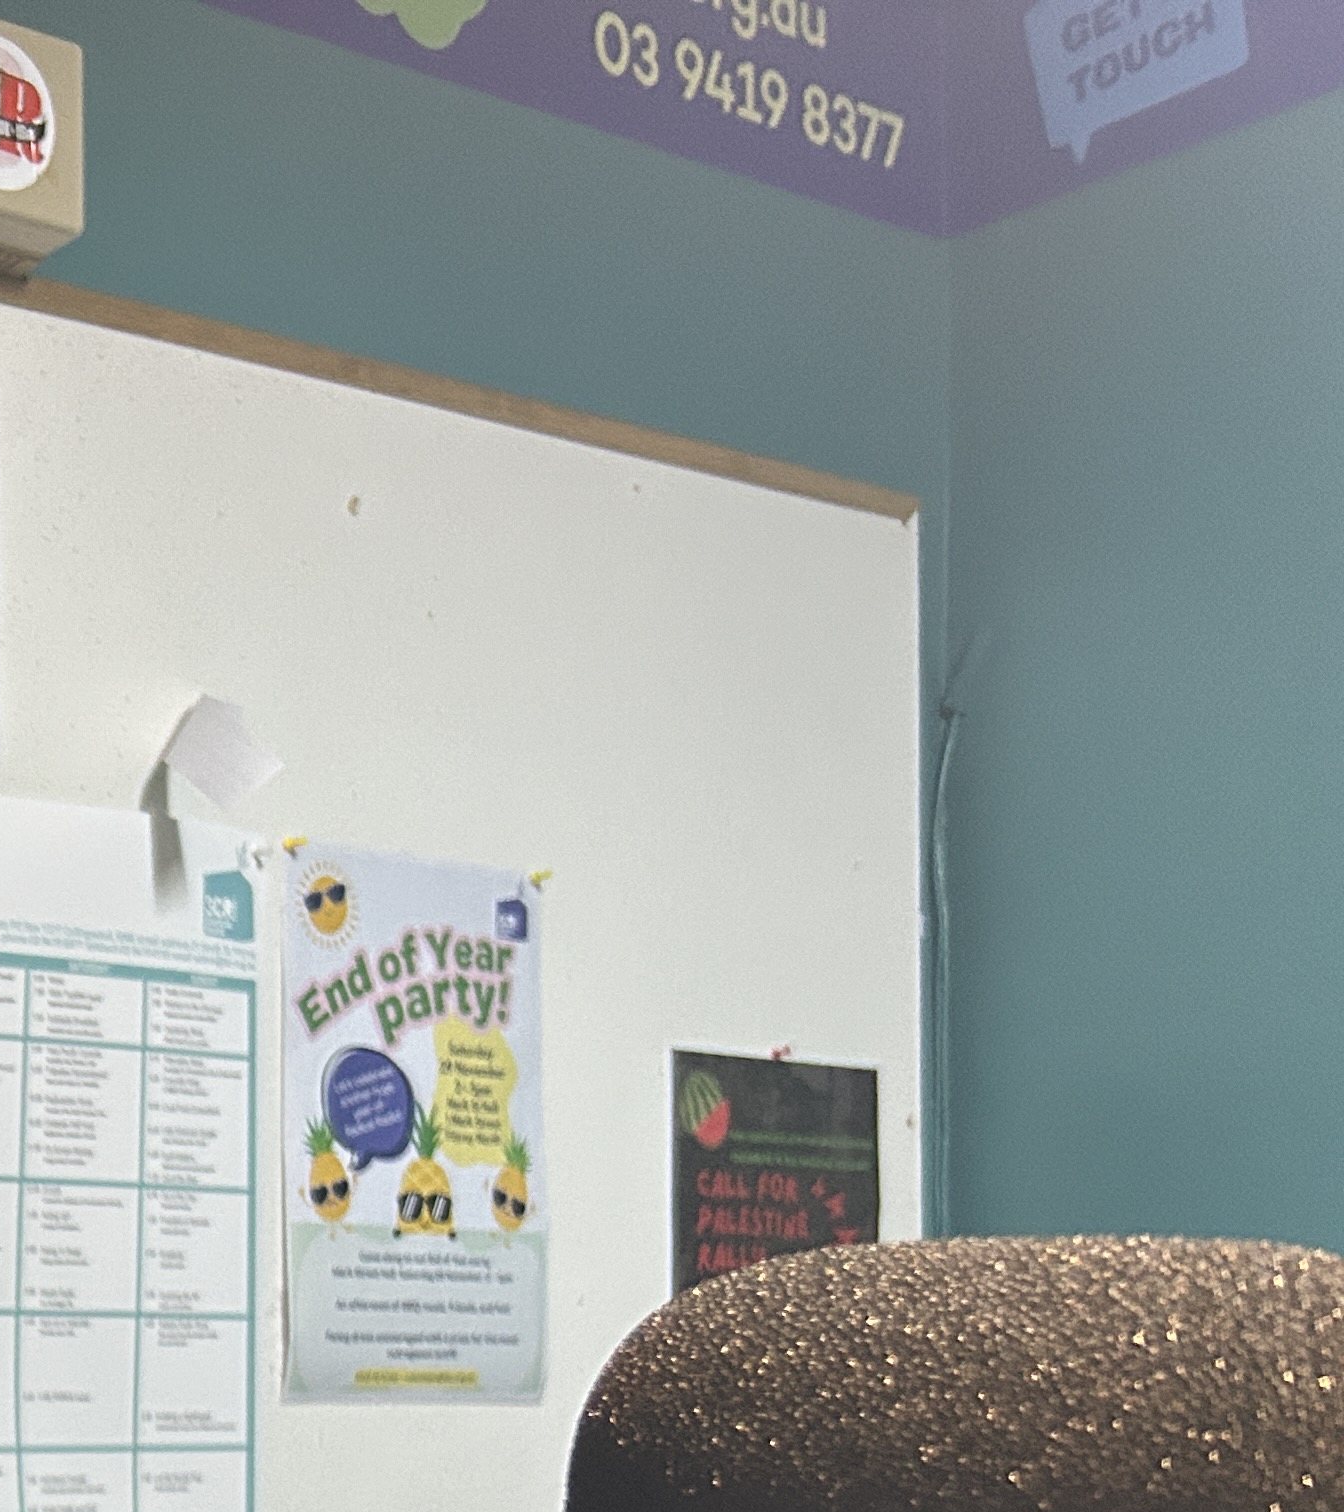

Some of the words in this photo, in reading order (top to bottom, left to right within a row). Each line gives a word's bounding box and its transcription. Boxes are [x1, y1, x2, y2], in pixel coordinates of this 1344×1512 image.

[594, 11, 659, 87] 03
[674, 38, 789, 129] 9419
[803, 84, 904, 169] 8377
[1068, 0, 1215, 103] TOUCH
[297, 951, 373, 1034] End
[378, 932, 417, 983] of
[424, 930, 513, 973] Year
[375, 974, 511, 1046] party!
[696, 1168, 750, 1200] CALL
